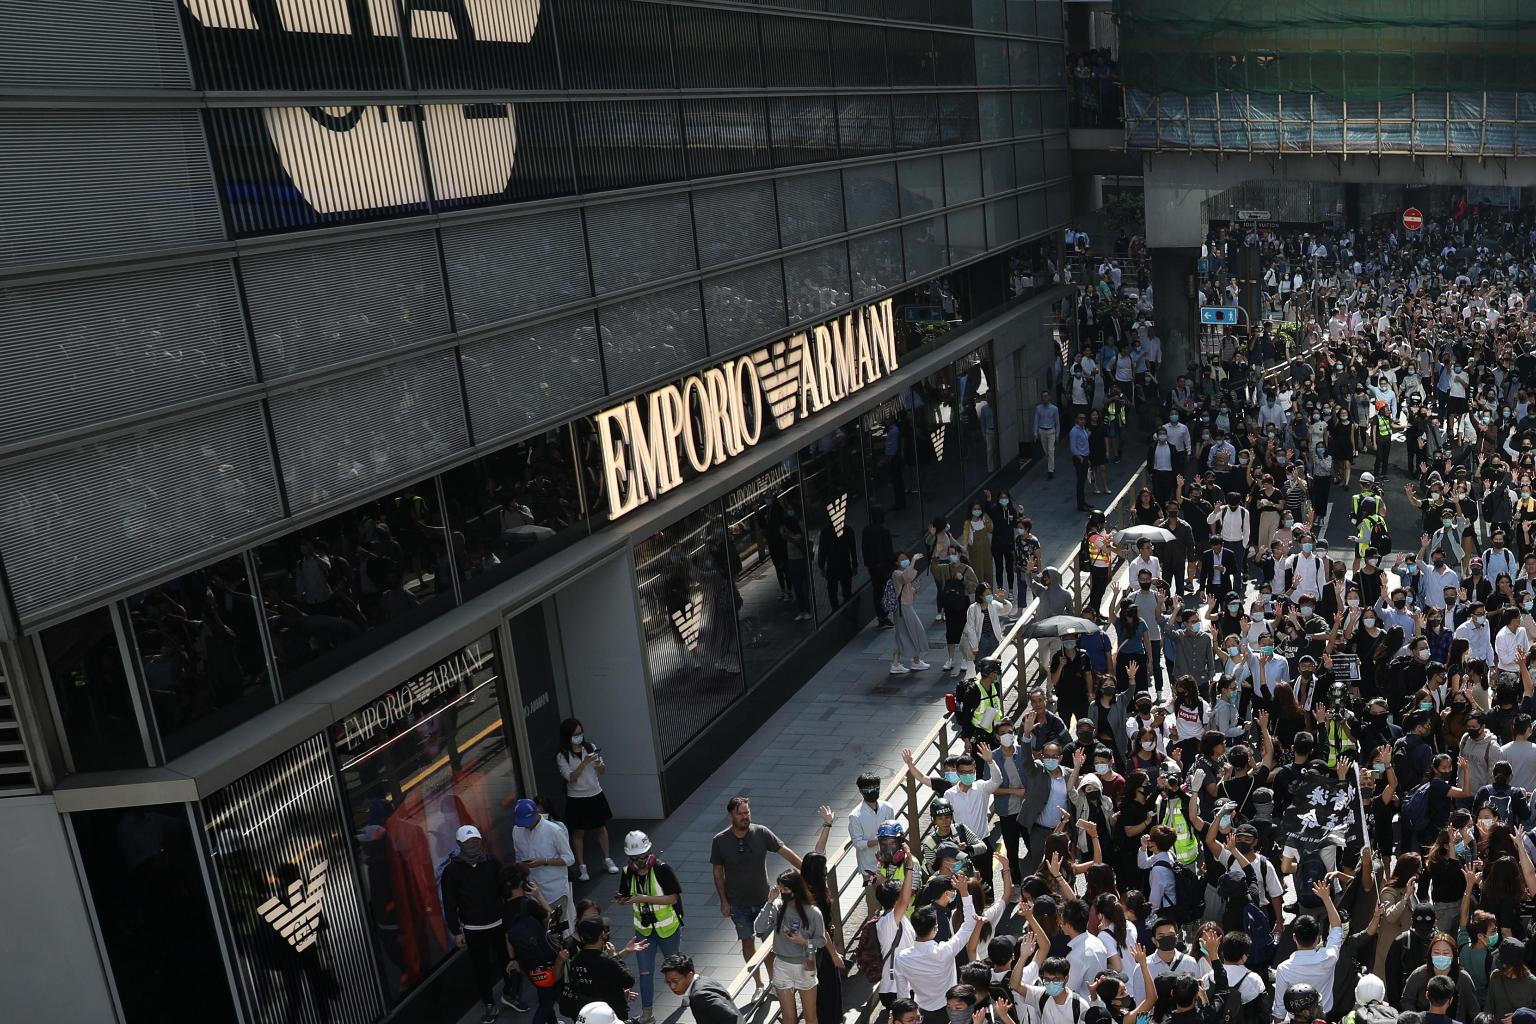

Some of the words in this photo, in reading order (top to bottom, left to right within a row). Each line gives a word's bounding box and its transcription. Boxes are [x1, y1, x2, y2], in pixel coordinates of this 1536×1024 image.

[596, 358, 763, 521] EMPORIO
[799, 297, 899, 421] ARMANI
[344, 684, 413, 752] EMPORIO
[433, 644, 485, 697] ARMANI
[936, 807, 951, 815] PRESS
[1289, 992, 1316, 1009] PRESS
